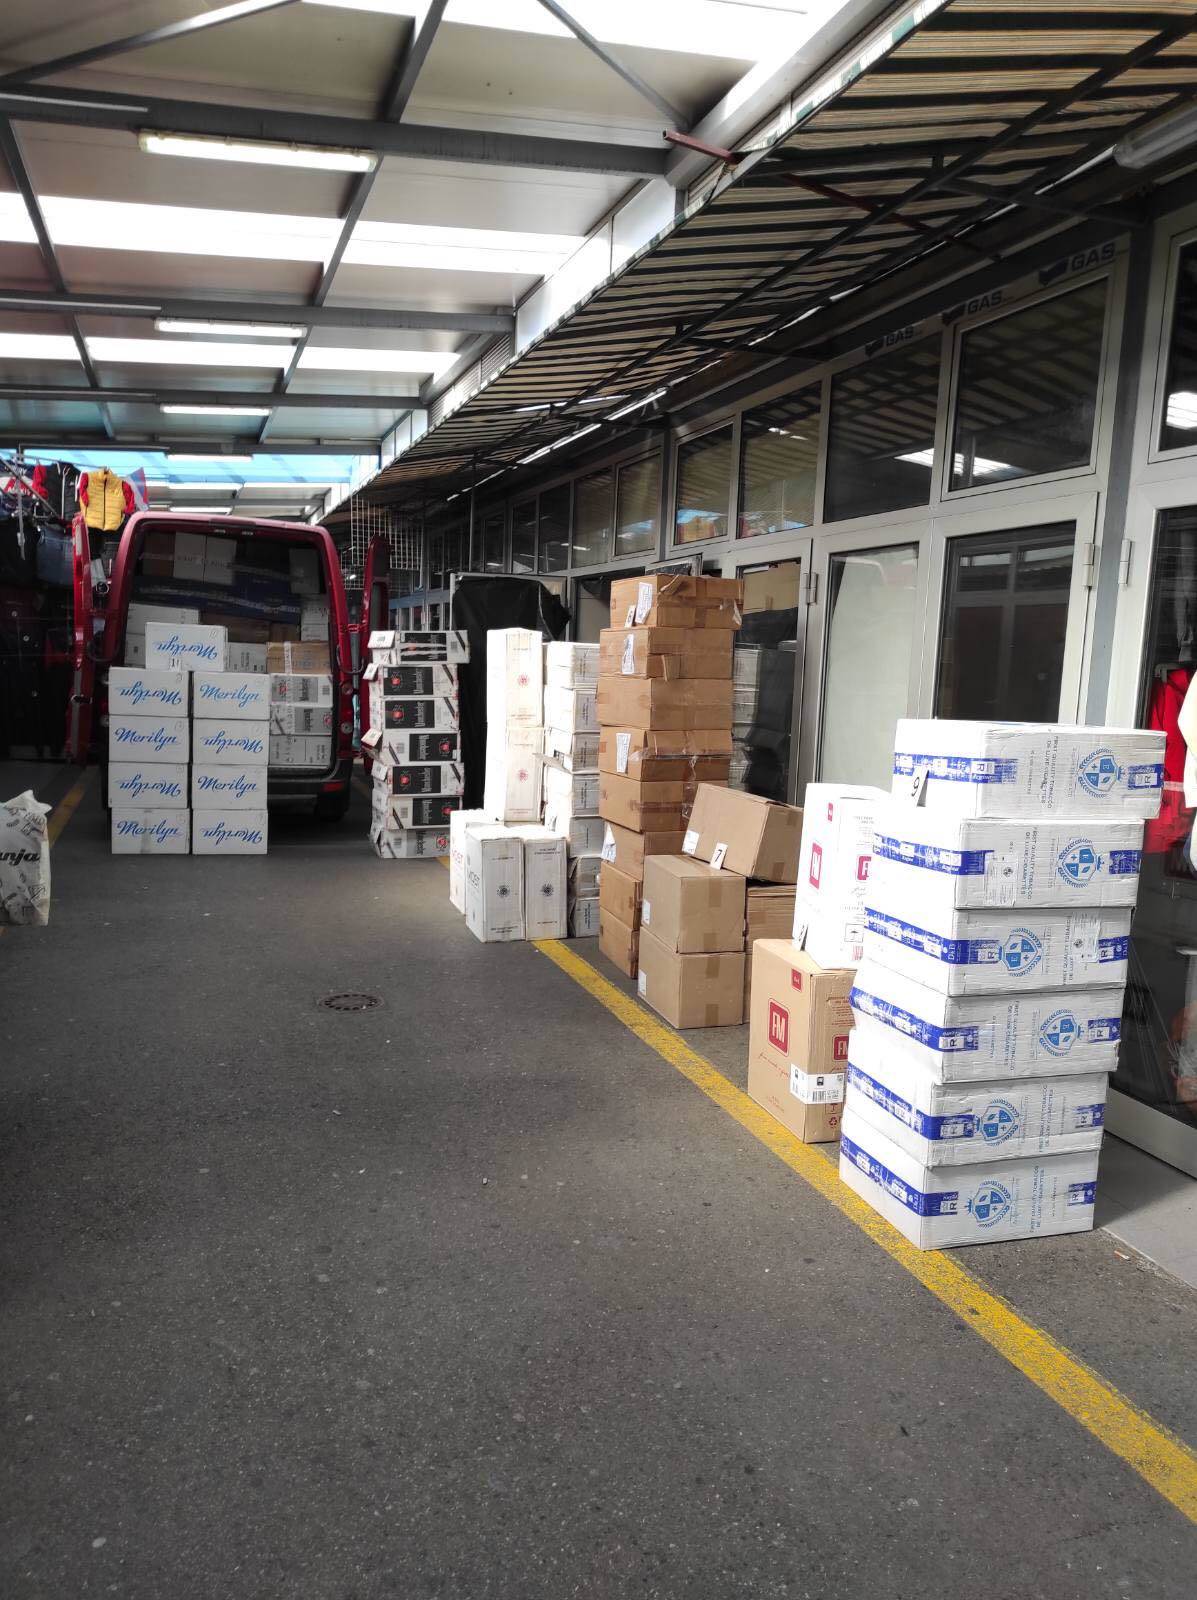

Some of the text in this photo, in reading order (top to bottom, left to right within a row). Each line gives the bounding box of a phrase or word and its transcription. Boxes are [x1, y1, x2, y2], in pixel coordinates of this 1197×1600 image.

[1071, 241, 1116, 271] GAS
[967, 291, 1002, 314] GAS
[885, 326, 914, 347] GAS
[911, 777, 919, 797] 9
[714, 849, 723, 863] 7
[773, 1012, 785, 1043] FM
